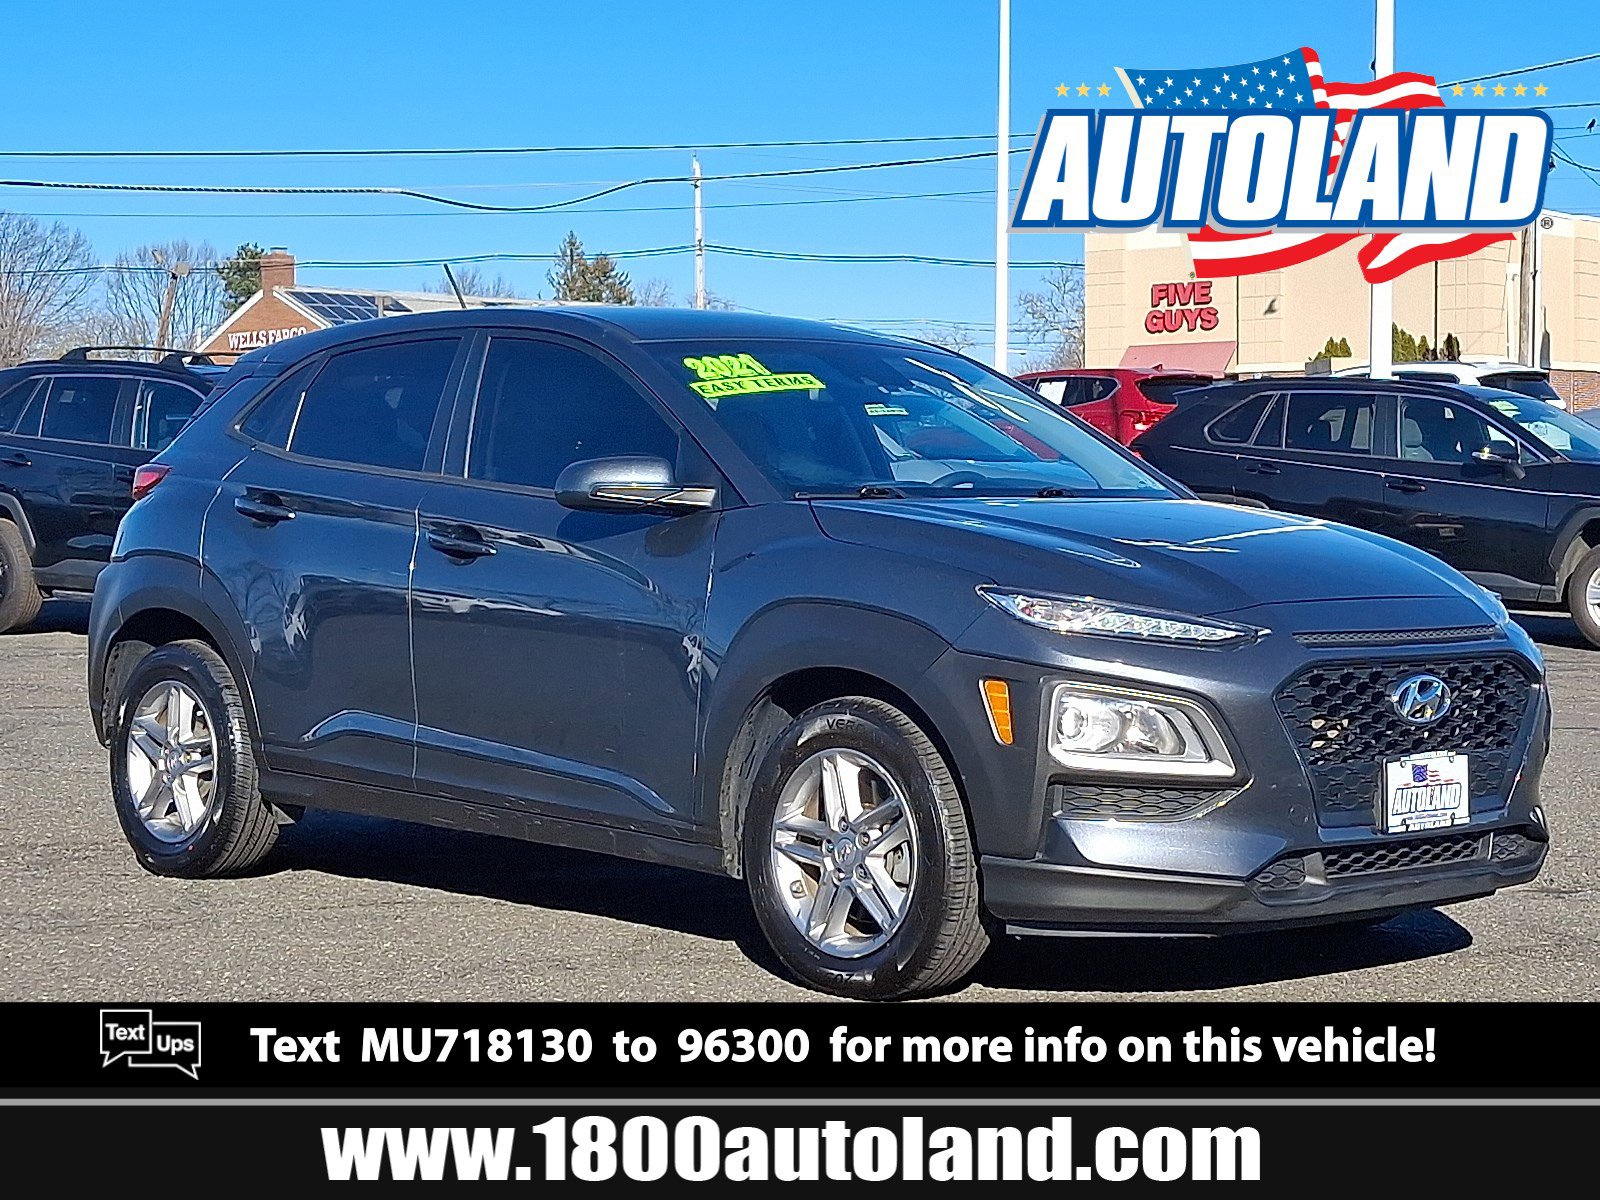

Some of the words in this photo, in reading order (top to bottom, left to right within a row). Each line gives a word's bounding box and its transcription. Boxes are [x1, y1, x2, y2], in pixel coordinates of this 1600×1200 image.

[1151, 281, 1212, 308] FIVE
[1145, 307, 1219, 334] GUYS
[228, 330, 267, 350] WELLS
[696, 380, 745, 394] EASY
[753, 375, 815, 389] TERMS
[1392, 783, 1462, 815] AUTOLAND
